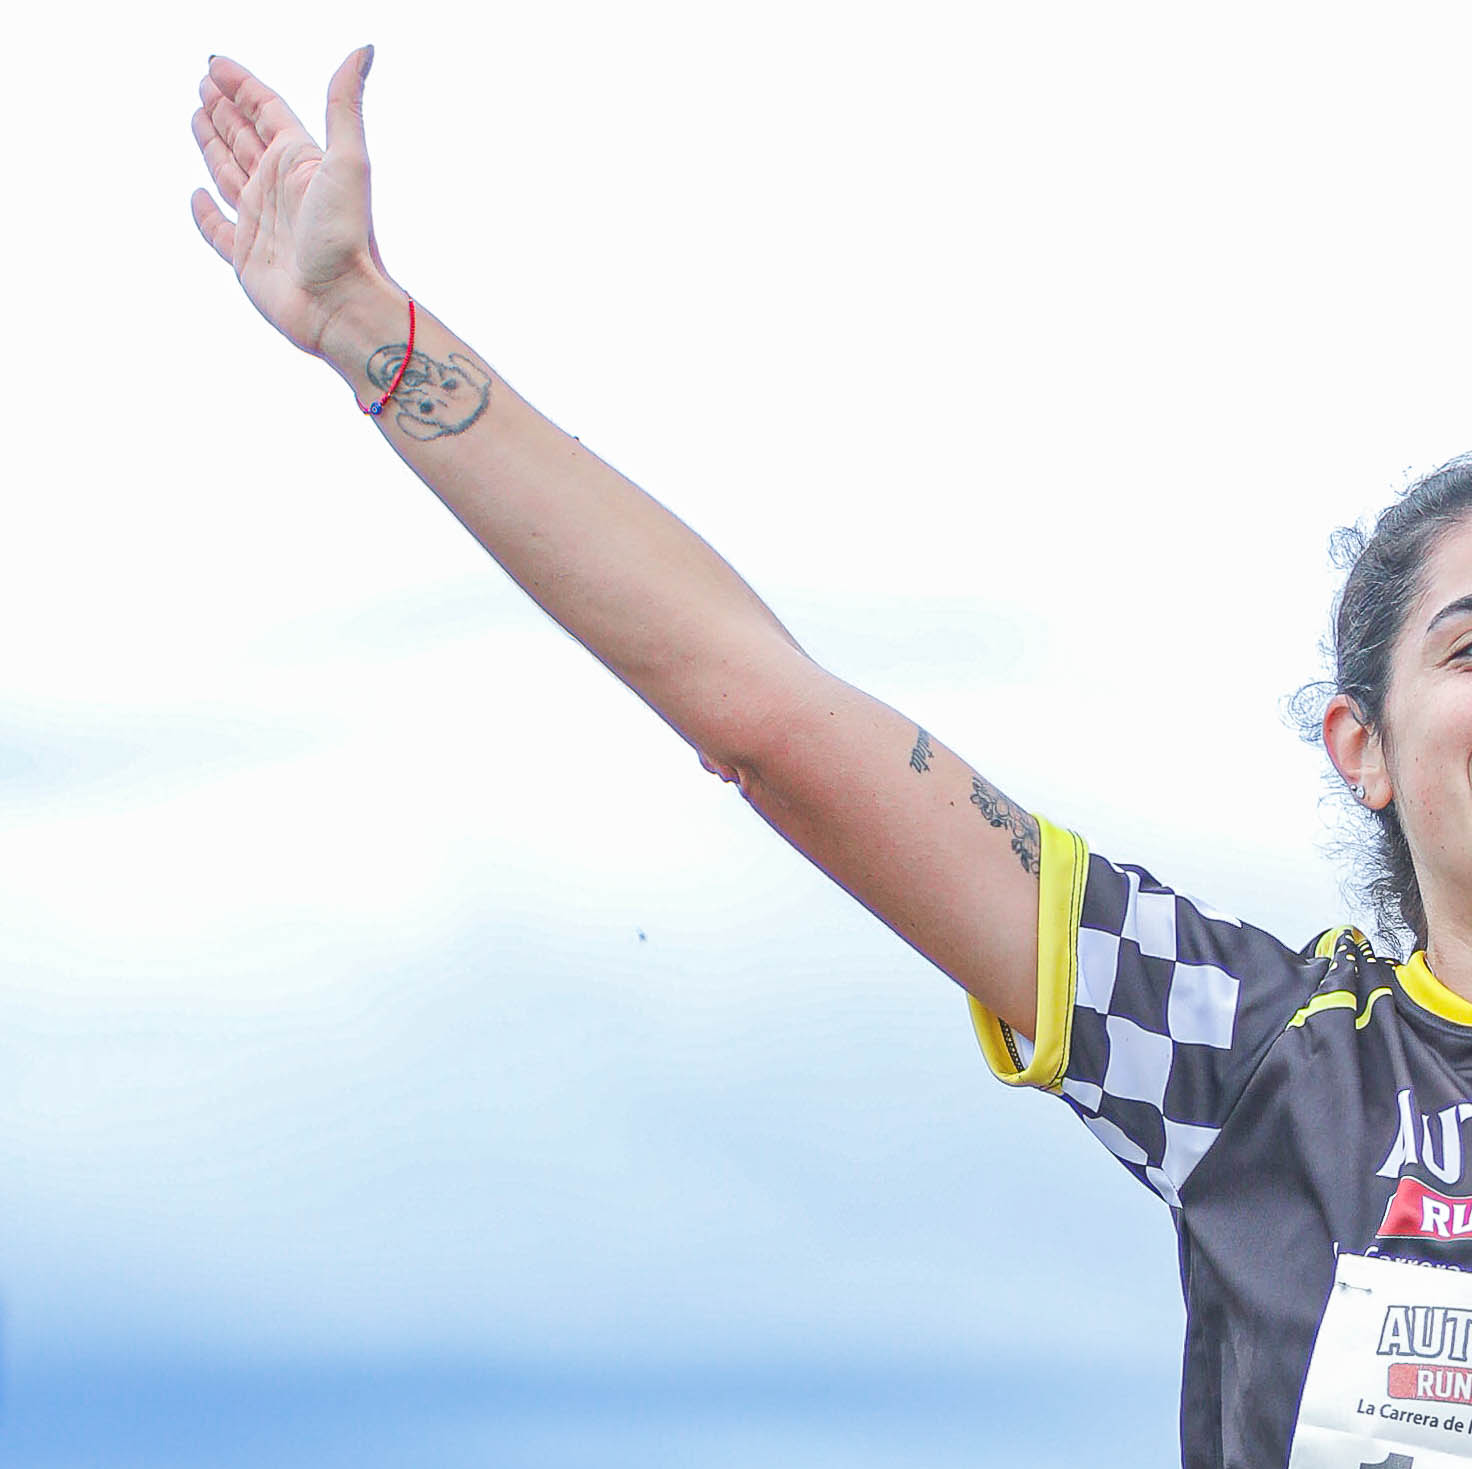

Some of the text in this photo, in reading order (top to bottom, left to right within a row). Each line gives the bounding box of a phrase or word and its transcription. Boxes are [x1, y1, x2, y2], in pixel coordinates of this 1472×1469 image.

[1357, 1398, 1375, 1416] La
[1379, 1402, 1439, 1428] Carrera
[1443, 1414, 1464, 1433] de
